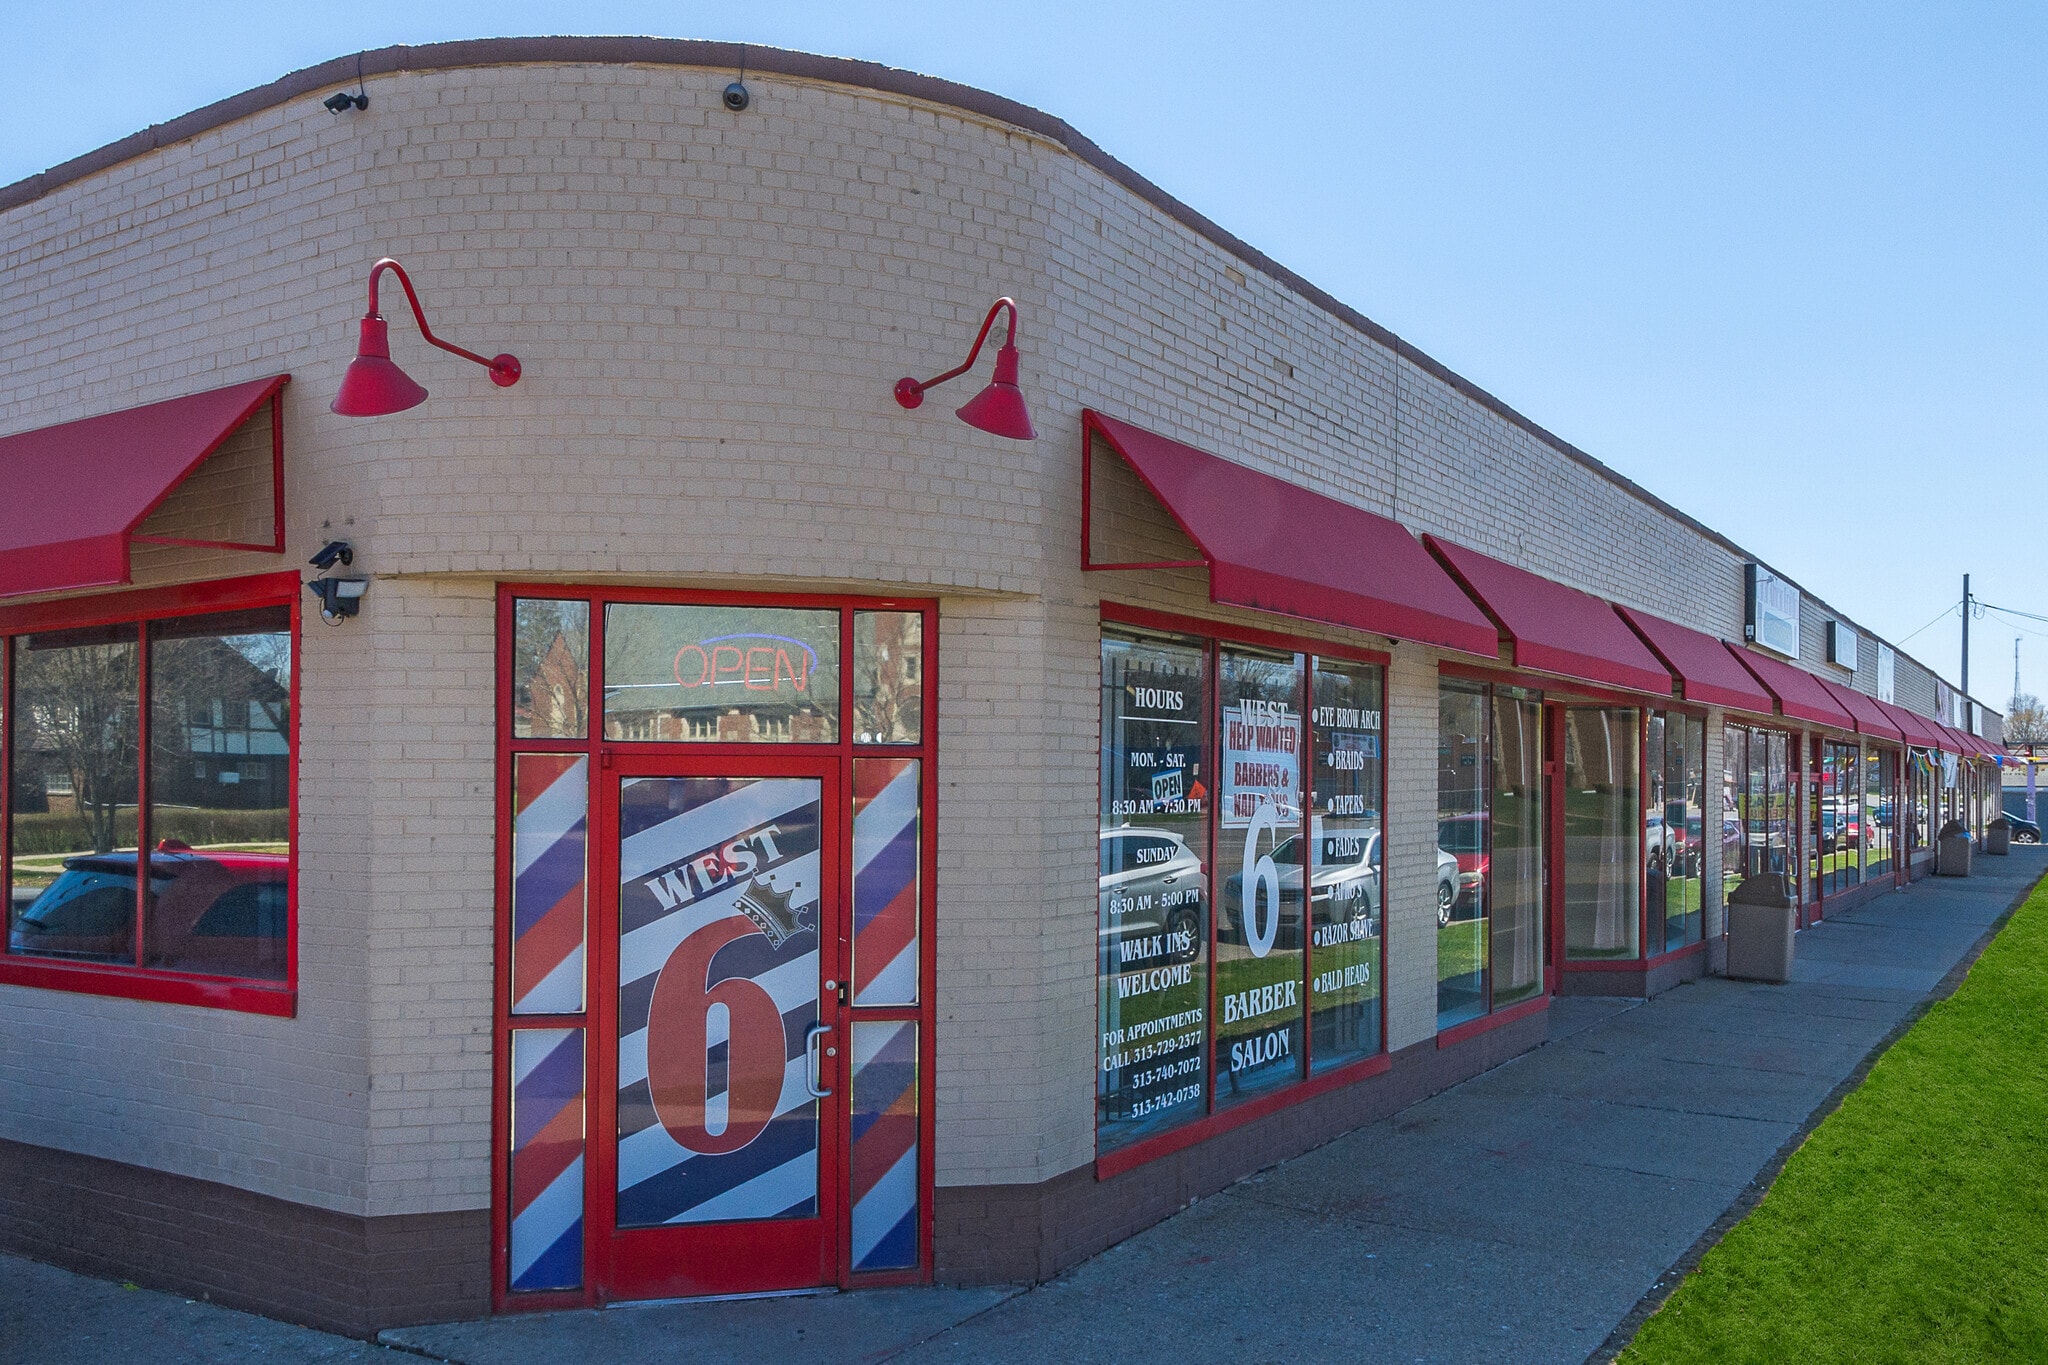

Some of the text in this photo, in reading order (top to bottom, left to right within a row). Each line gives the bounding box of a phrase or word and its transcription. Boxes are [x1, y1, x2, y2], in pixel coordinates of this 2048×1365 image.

[674, 644, 808, 691] OPEN
[1135, 687, 1183, 711] HOURS
[1239, 698, 1289, 727] WEST
[1320, 706, 1381, 730] EYE BROW ARCH
[1229, 720, 1254, 751] HELP
[1256, 725, 1296, 755] WANTED
[1131, 752, 1157, 767] MON.
[1166, 753, 1186, 768] SAT.
[1234, 762, 1289, 788] BARBERS &
[1335, 750, 1364, 770] BRAIDS
[1154, 774, 1181, 800] OPEN
[1112, 800, 1136, 815] 8:30
[1138, 799, 1154, 814] AM
[1163, 799, 1185, 814] 7:30
[1187, 799, 1201, 813] PM
[1335, 795, 1364, 815] TAPERS
[1136, 845, 1177, 864] SUNDAY
[1335, 836, 1360, 857] FADES
[644, 824, 783, 911] WEST
[1242, 802, 1279, 958] 6
[1110, 897, 1134, 915] 8:30
[1136, 895, 1152, 911] AM
[1161, 890, 1183, 907] 5:00
[1185, 889, 1199, 904] PM
[1120, 930, 1191, 963] WALK INS
[1322, 918, 1374, 947] RAZOR SHAVE
[1117, 964, 1191, 999] WELCOME
[1321, 963, 1370, 993] BALD HEADS
[1224, 980, 1297, 1024] BARBER
[647, 915, 787, 1155] 6
[1103, 1008, 1203, 1048] FOR APPOINTMENTS
[1103, 1030, 1202, 1072] CALL 313-729-2377
[1231, 1028, 1290, 1073] SALON
[1132, 1056, 1201, 1089] 313-740-7072
[1131, 1083, 1200, 1118] 313-742-0738
